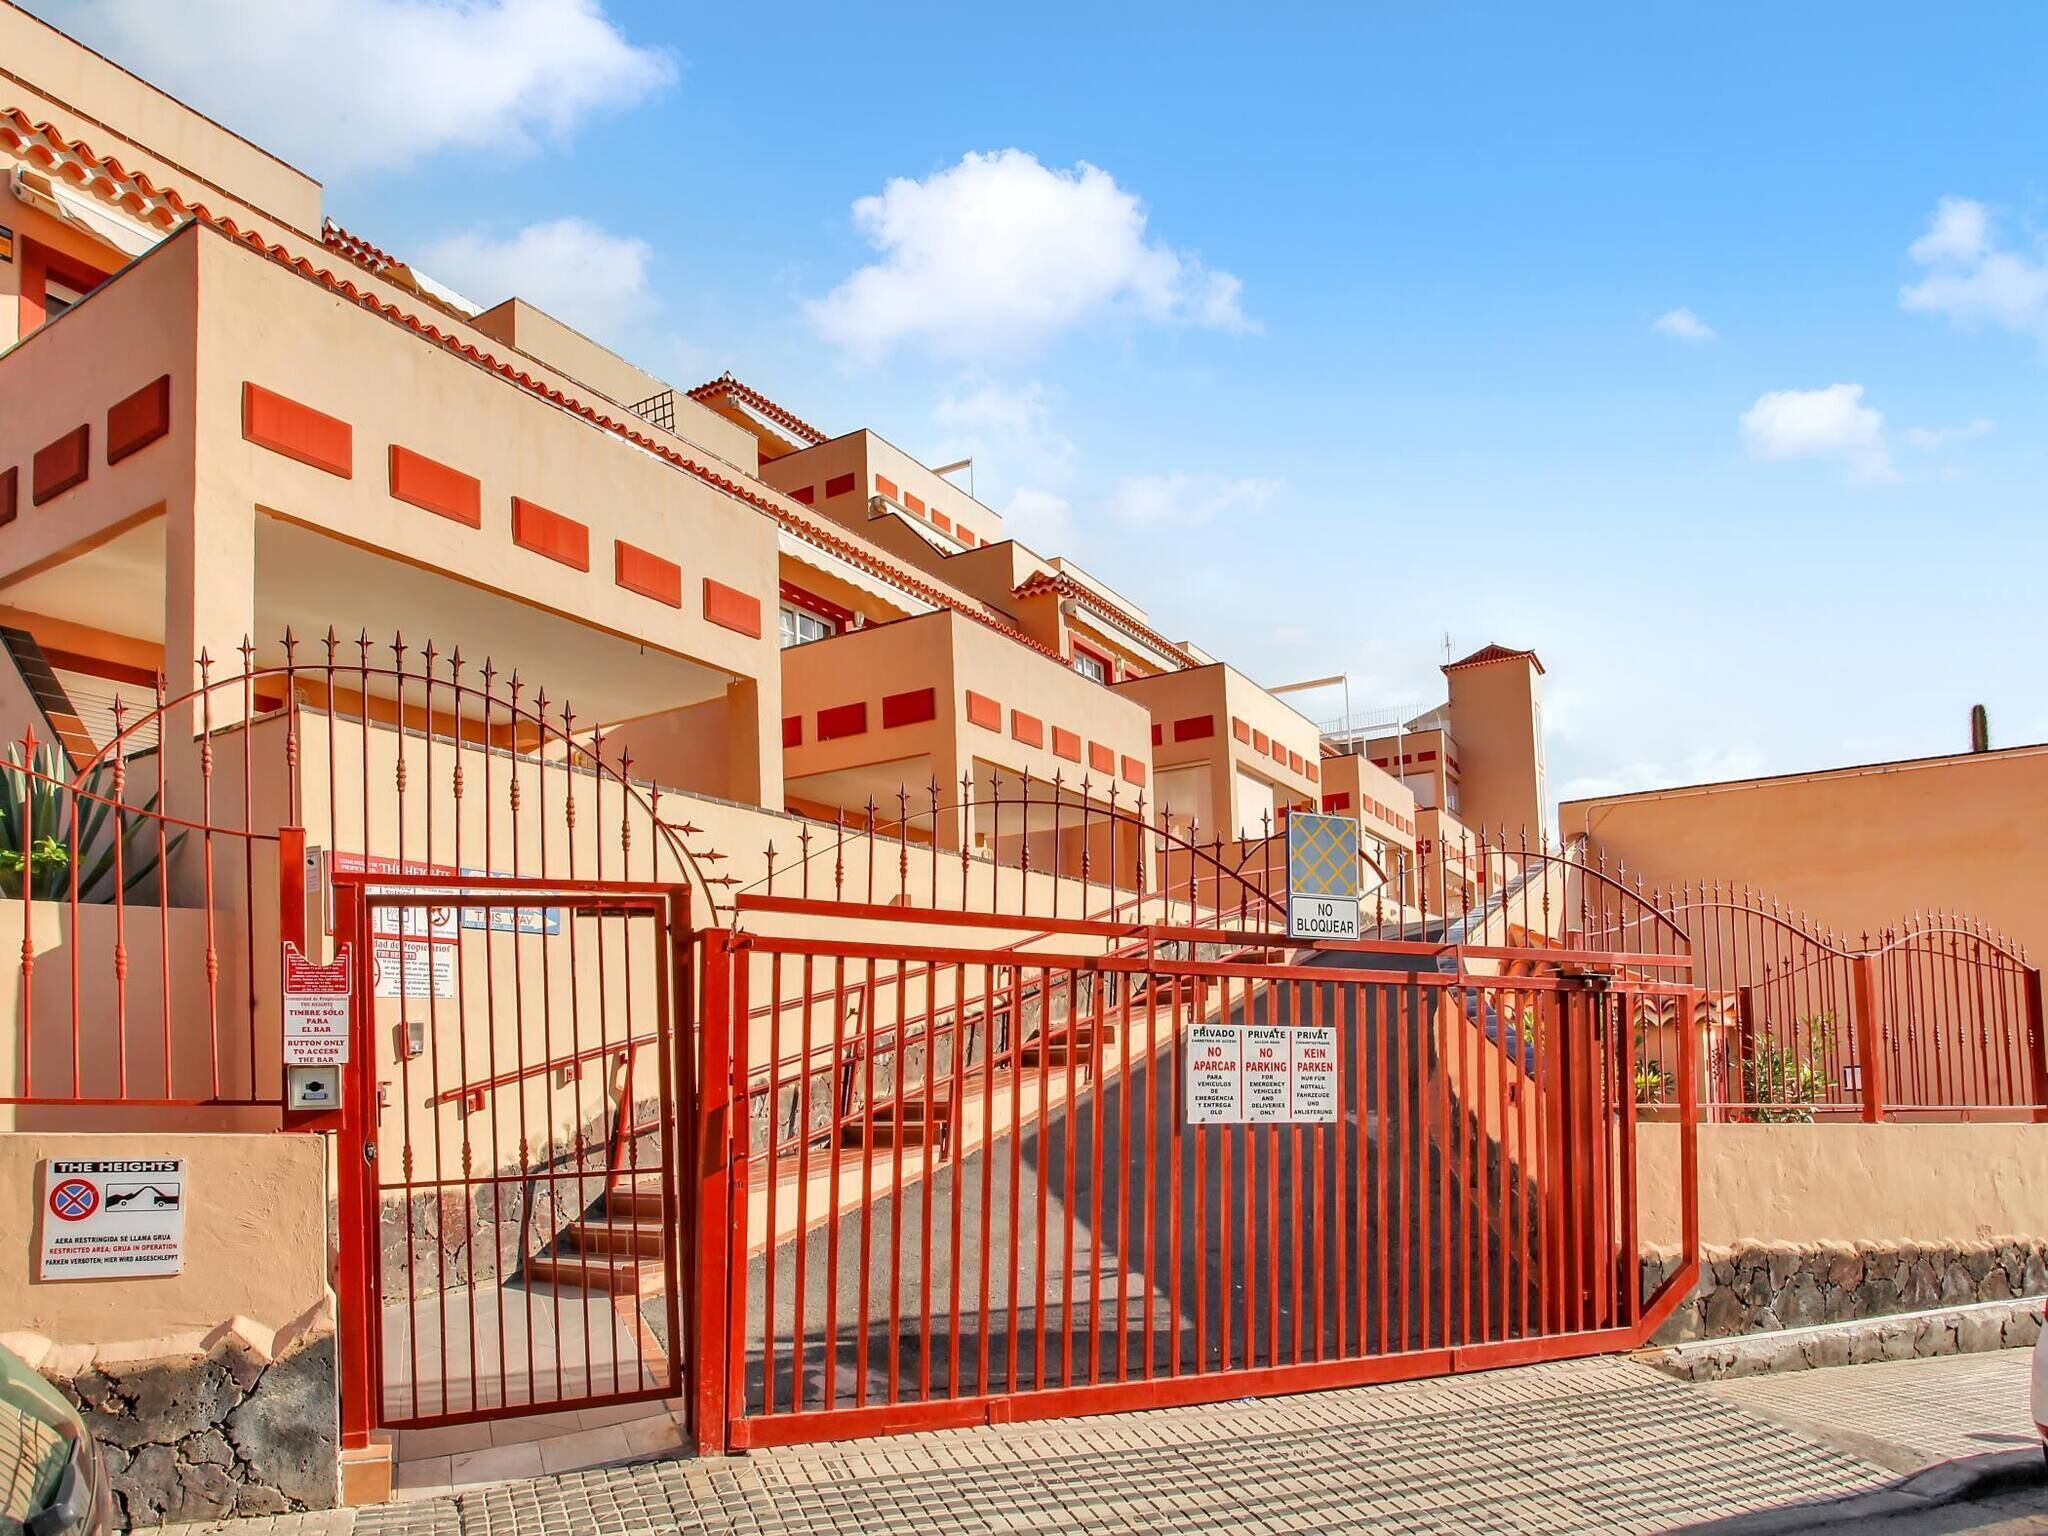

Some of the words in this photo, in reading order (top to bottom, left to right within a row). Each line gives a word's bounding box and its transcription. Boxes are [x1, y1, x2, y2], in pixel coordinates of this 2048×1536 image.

[1318, 903, 1333, 917] NO
[475, 911, 502, 923] TIS
[1296, 918, 1354, 934] BLOQUEAR
[402, 942, 452, 952] ropierios
[1193, 1029, 1236, 1038] PRIVADO
[1248, 1030, 1286, 1039] PRIVATE
[1207, 1046, 1222, 1057] NO
[1259, 1047, 1273, 1058] NO
[1304, 1048, 1326, 1058] KEIN
[1193, 1060, 1236, 1071] APARCAR
[1246, 1061, 1287, 1072] PARKING
[1297, 1062, 1333, 1072] PARKEN
[58, 1162, 94, 1172] THE
[99, 1161, 175, 1172] HEIGHTS
[74, 1236, 119, 1244] RESTRINGIDA
[130, 1234, 152, 1242] LLAMA
[49, 1246, 91, 1255] RESTRICTED
[141, 1243, 178, 1251] OPERATION
[104, 1256, 117, 1264] HIER
[118, 1255, 134, 1263] WIRD
[134, 1254, 179, 1262] ABGESCHLEPPT
